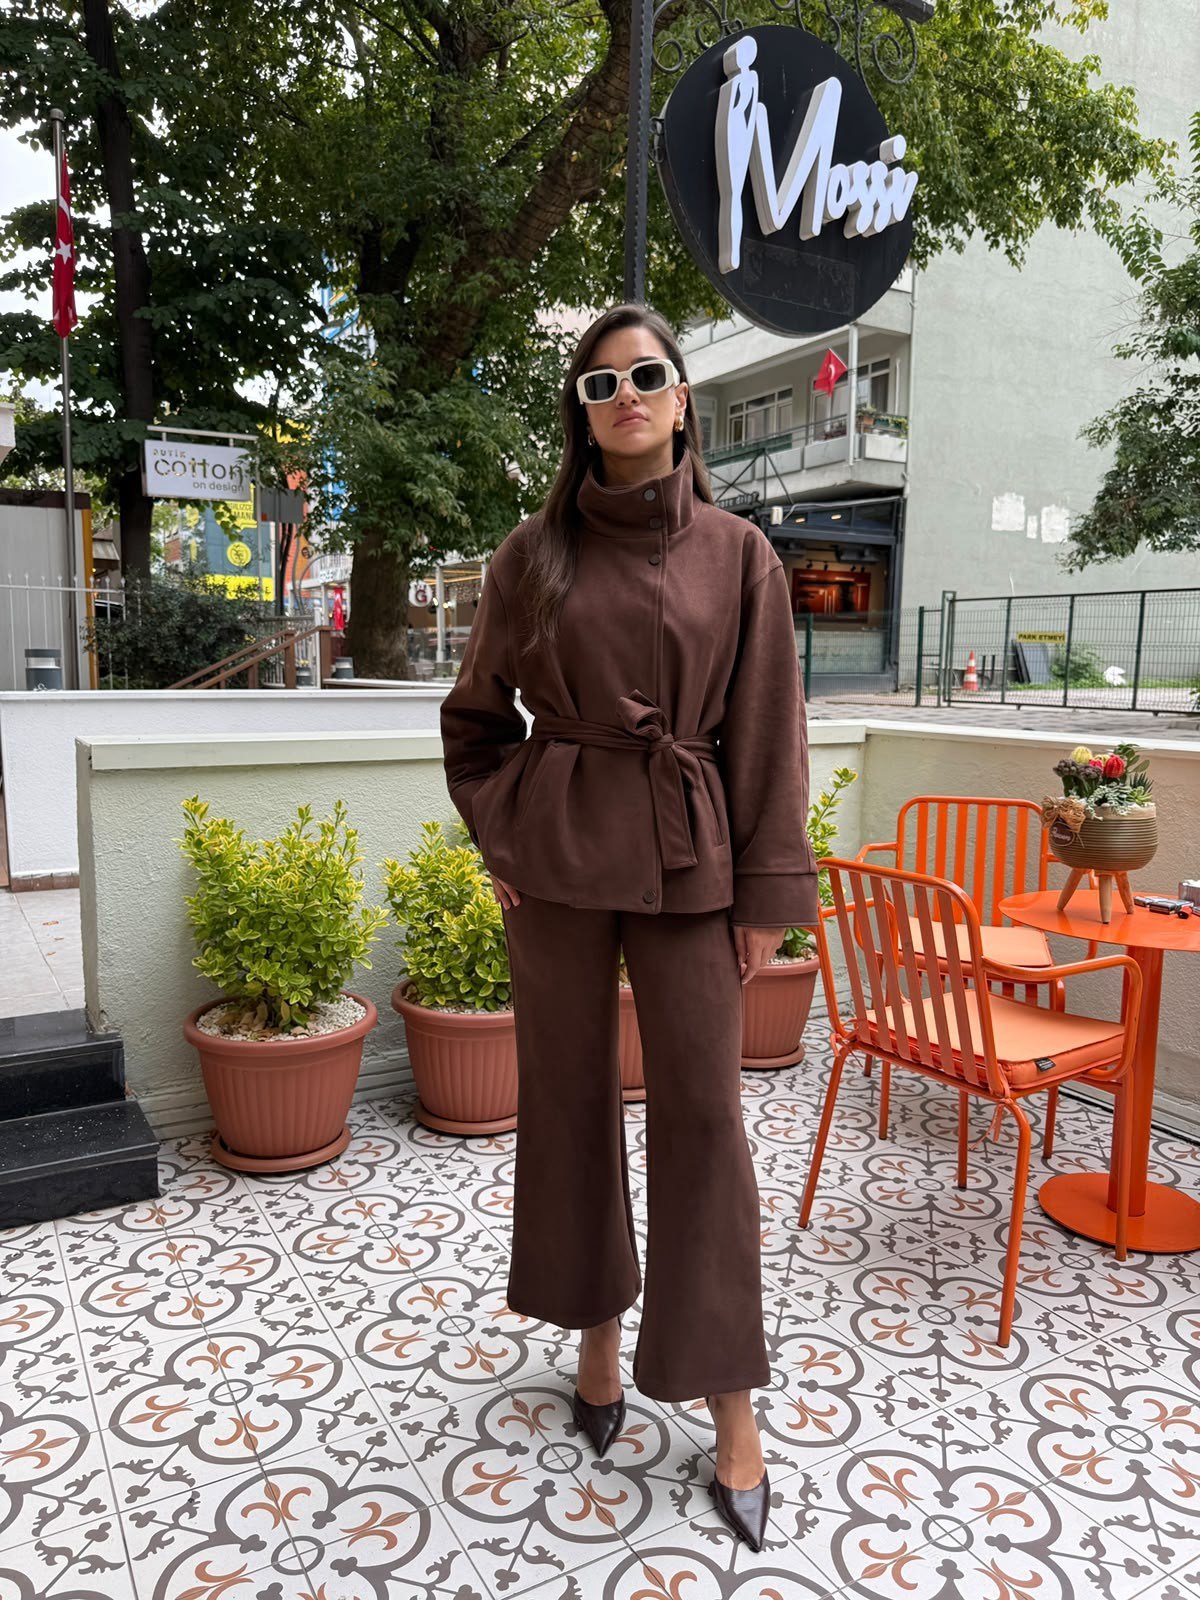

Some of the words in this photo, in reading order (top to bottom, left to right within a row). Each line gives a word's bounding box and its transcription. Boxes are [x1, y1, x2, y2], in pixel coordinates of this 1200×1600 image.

[154, 457, 244, 483] cotton
[193, 481, 206, 489] on
[209, 480, 244, 493] design
[1018, 633, 1037, 641] PARK
